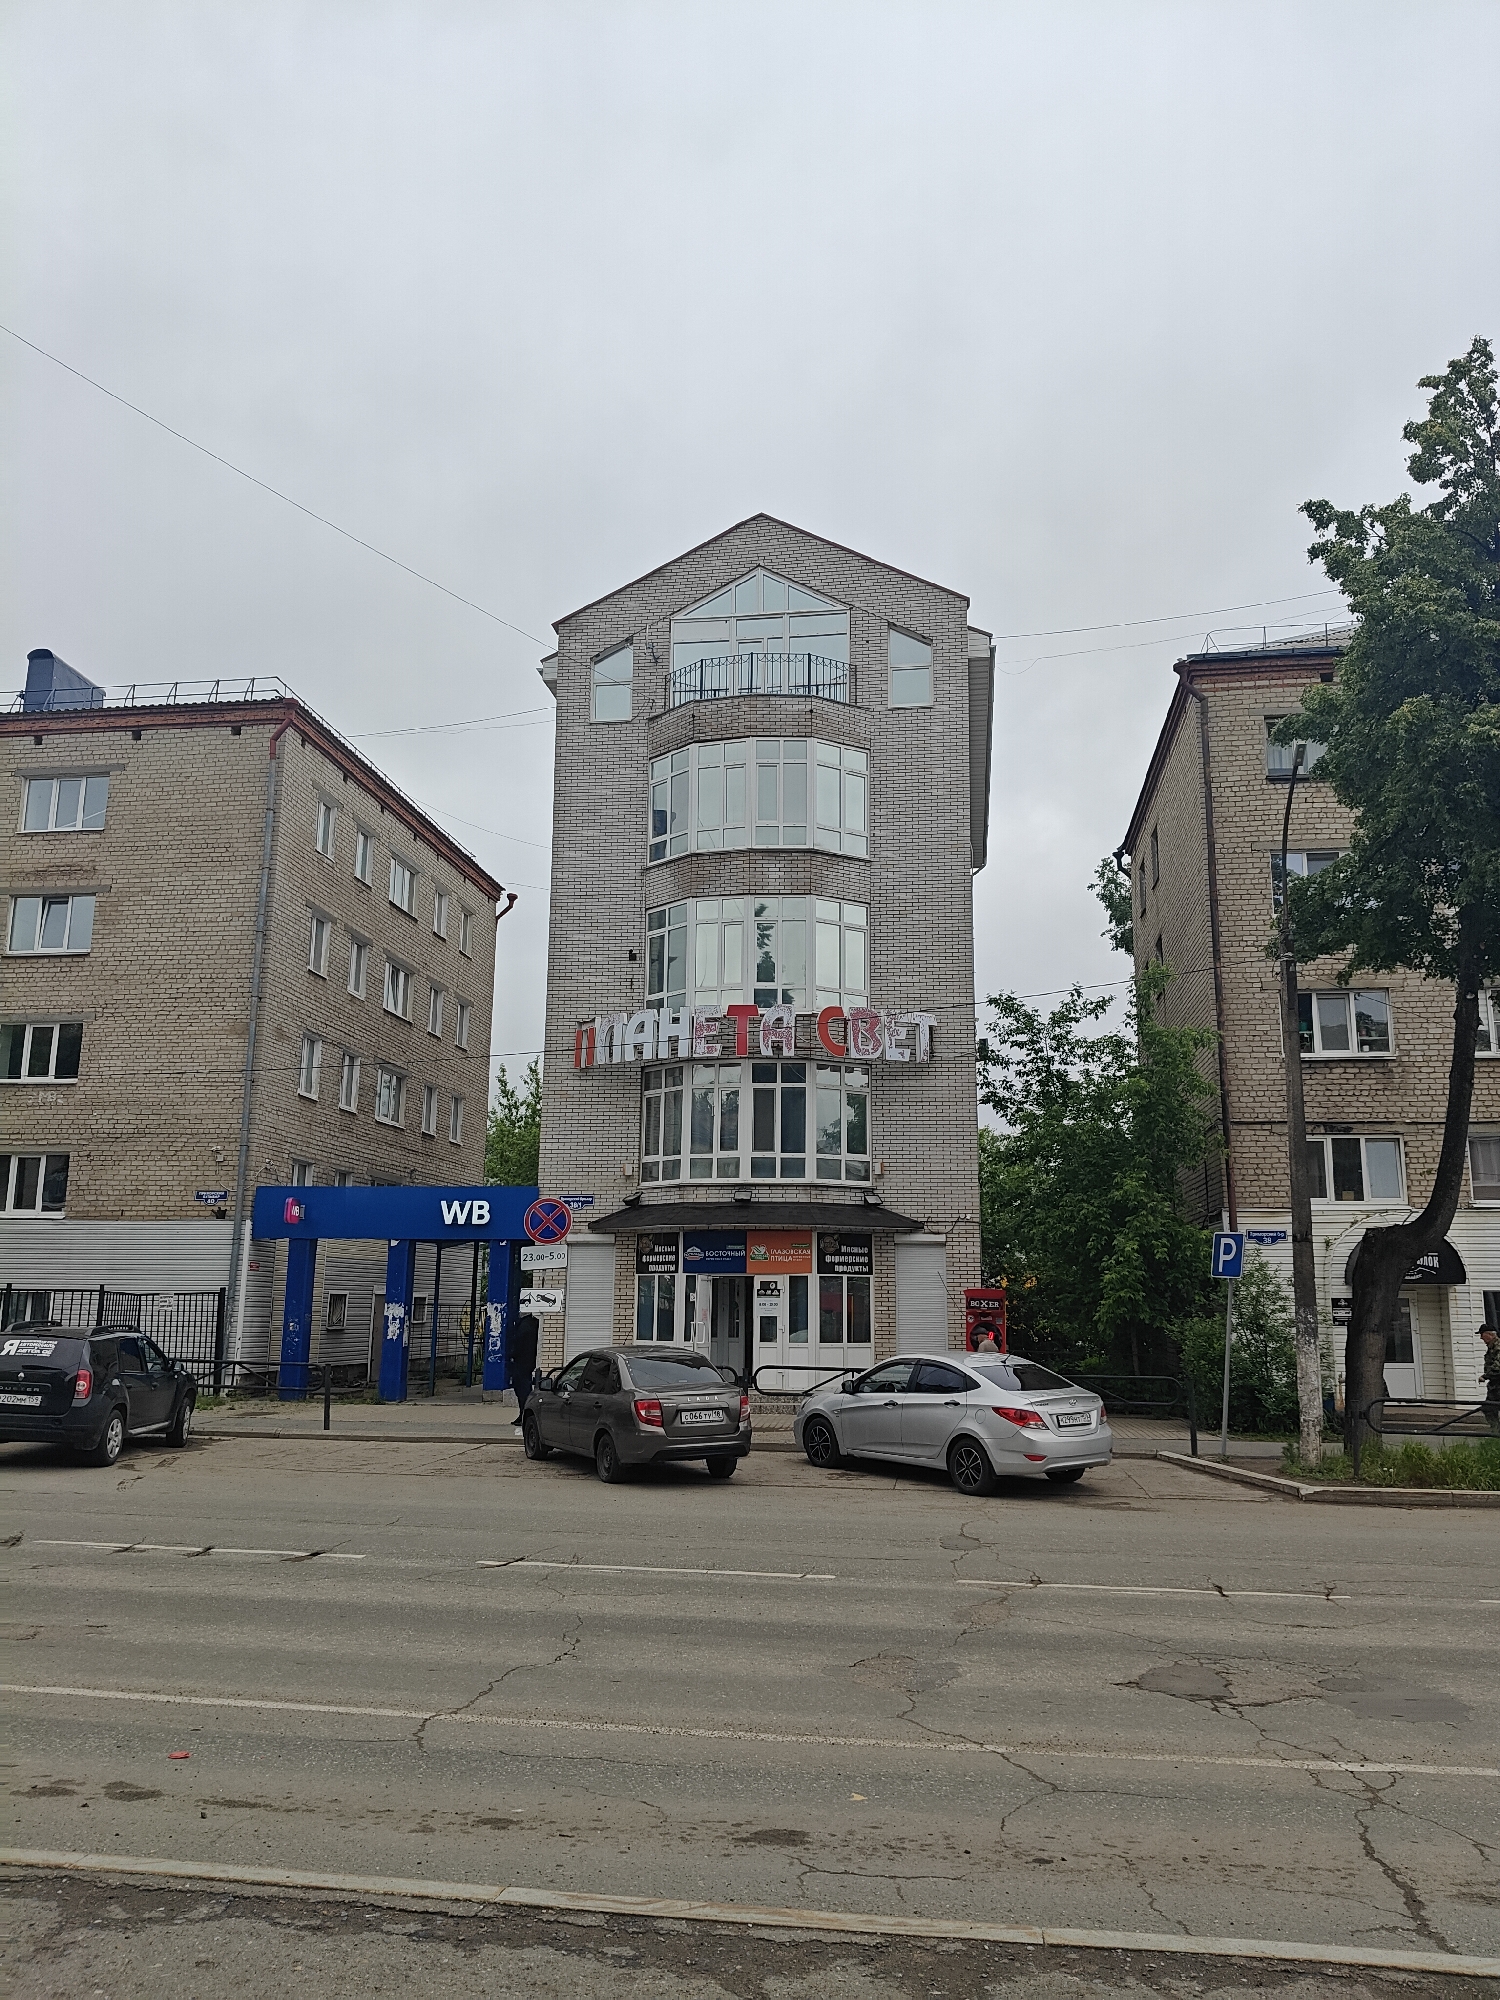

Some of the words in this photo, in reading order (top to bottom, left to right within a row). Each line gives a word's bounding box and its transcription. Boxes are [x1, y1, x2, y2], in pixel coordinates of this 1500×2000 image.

[574, 1004, 795, 1069] ПЛАНЕТА
[816, 1005, 937, 1064] СВЕТ
[441, 1200, 490, 1225] WB
[705, 1249, 746, 1257] ВОСТОЧНЫЙ
[0, 1339, 21, 1356] Я
